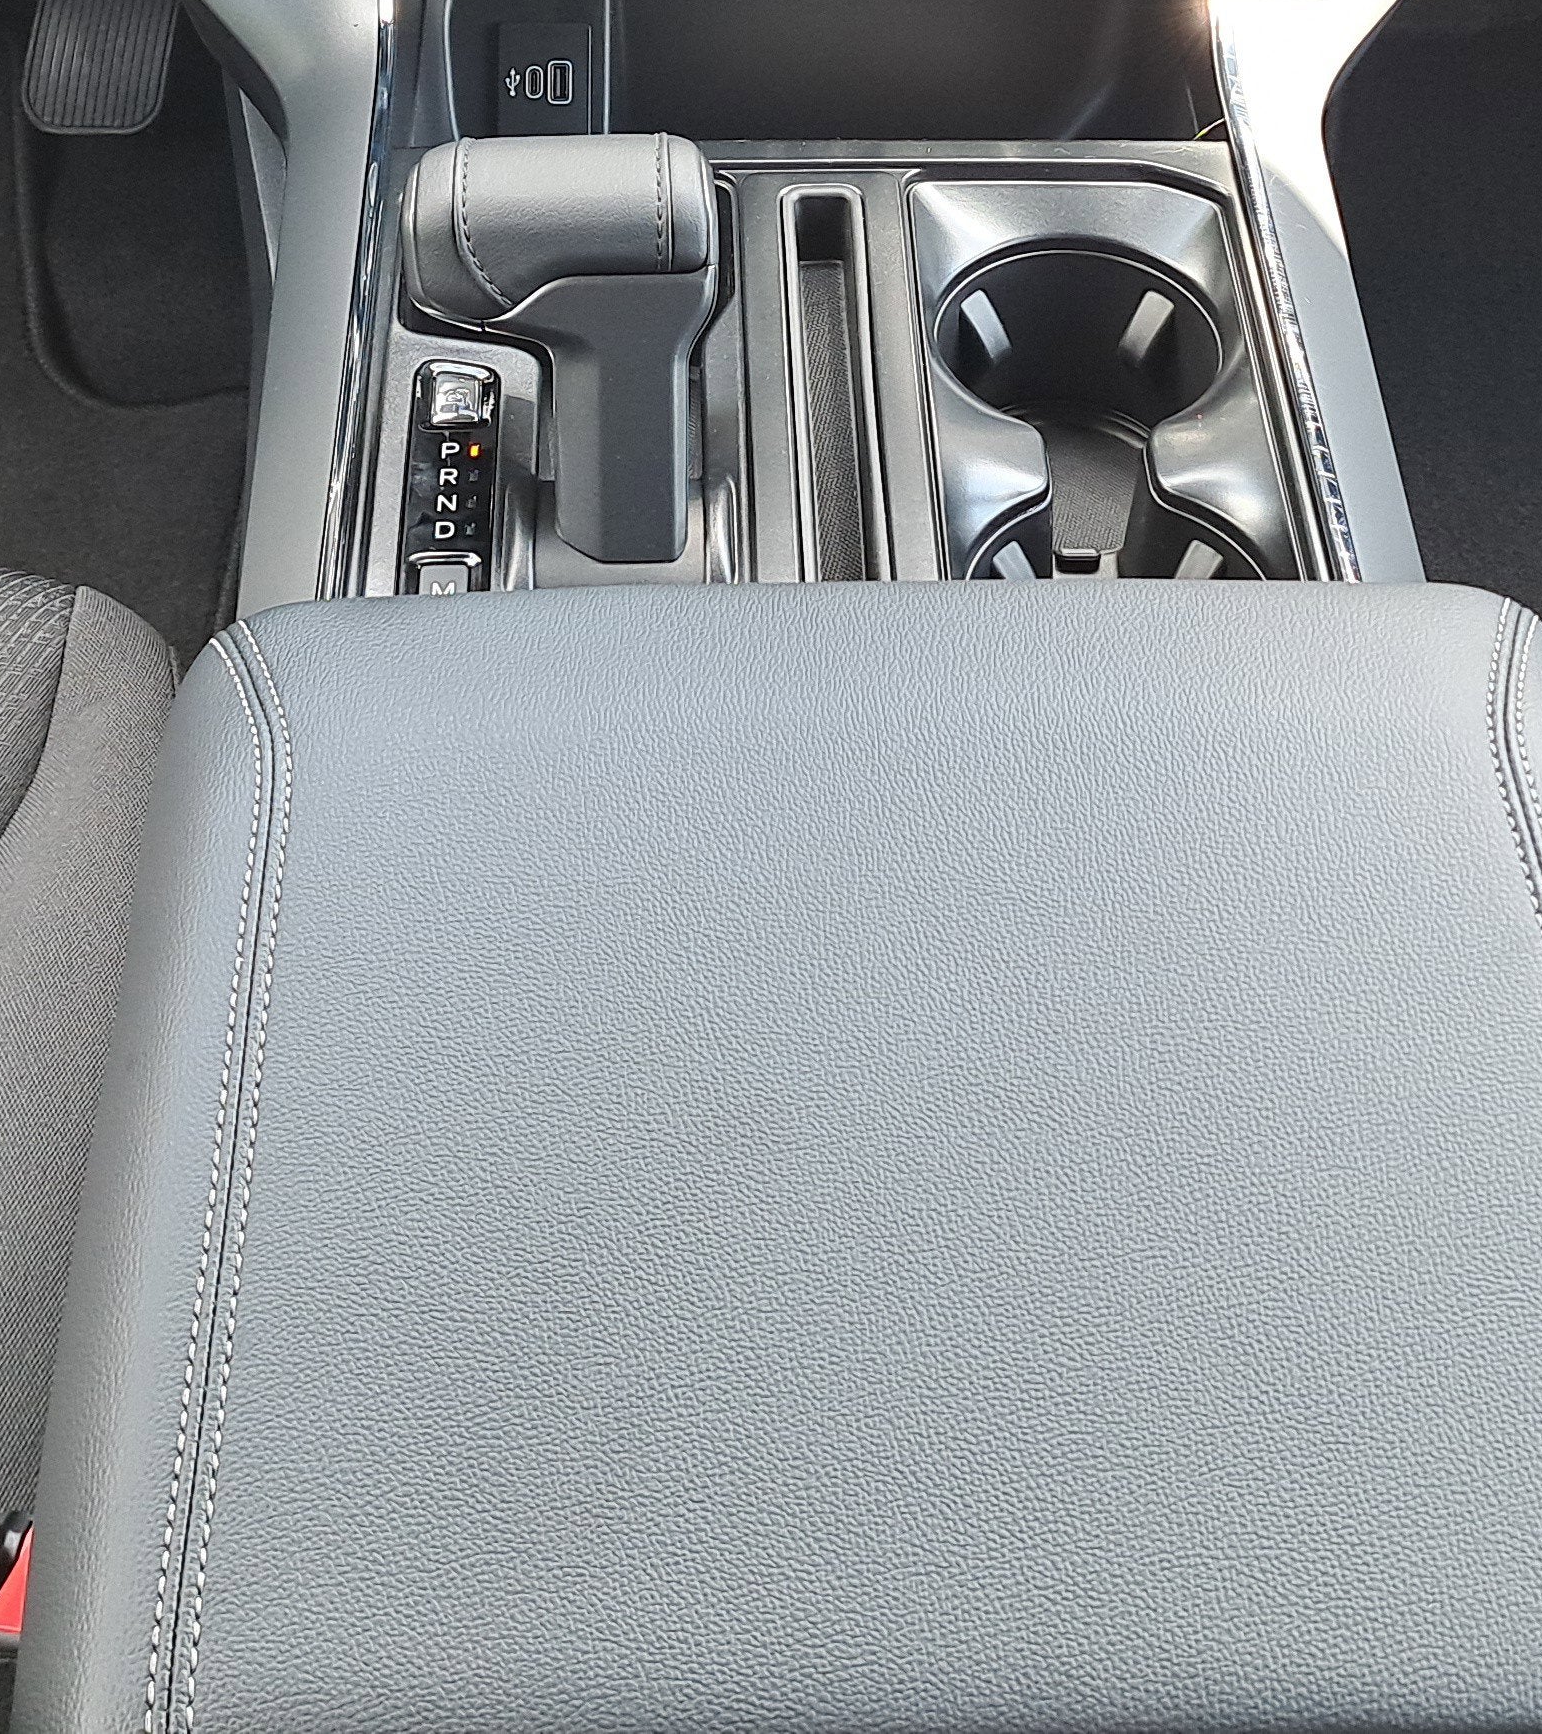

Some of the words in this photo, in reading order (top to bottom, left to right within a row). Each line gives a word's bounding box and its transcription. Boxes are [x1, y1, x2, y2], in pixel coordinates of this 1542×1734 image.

[441, 443, 460, 459] P
[439, 468, 458, 486] R
[437, 495, 457, 512] N
[435, 522, 455, 539] D
[431, 582, 455, 596] M
